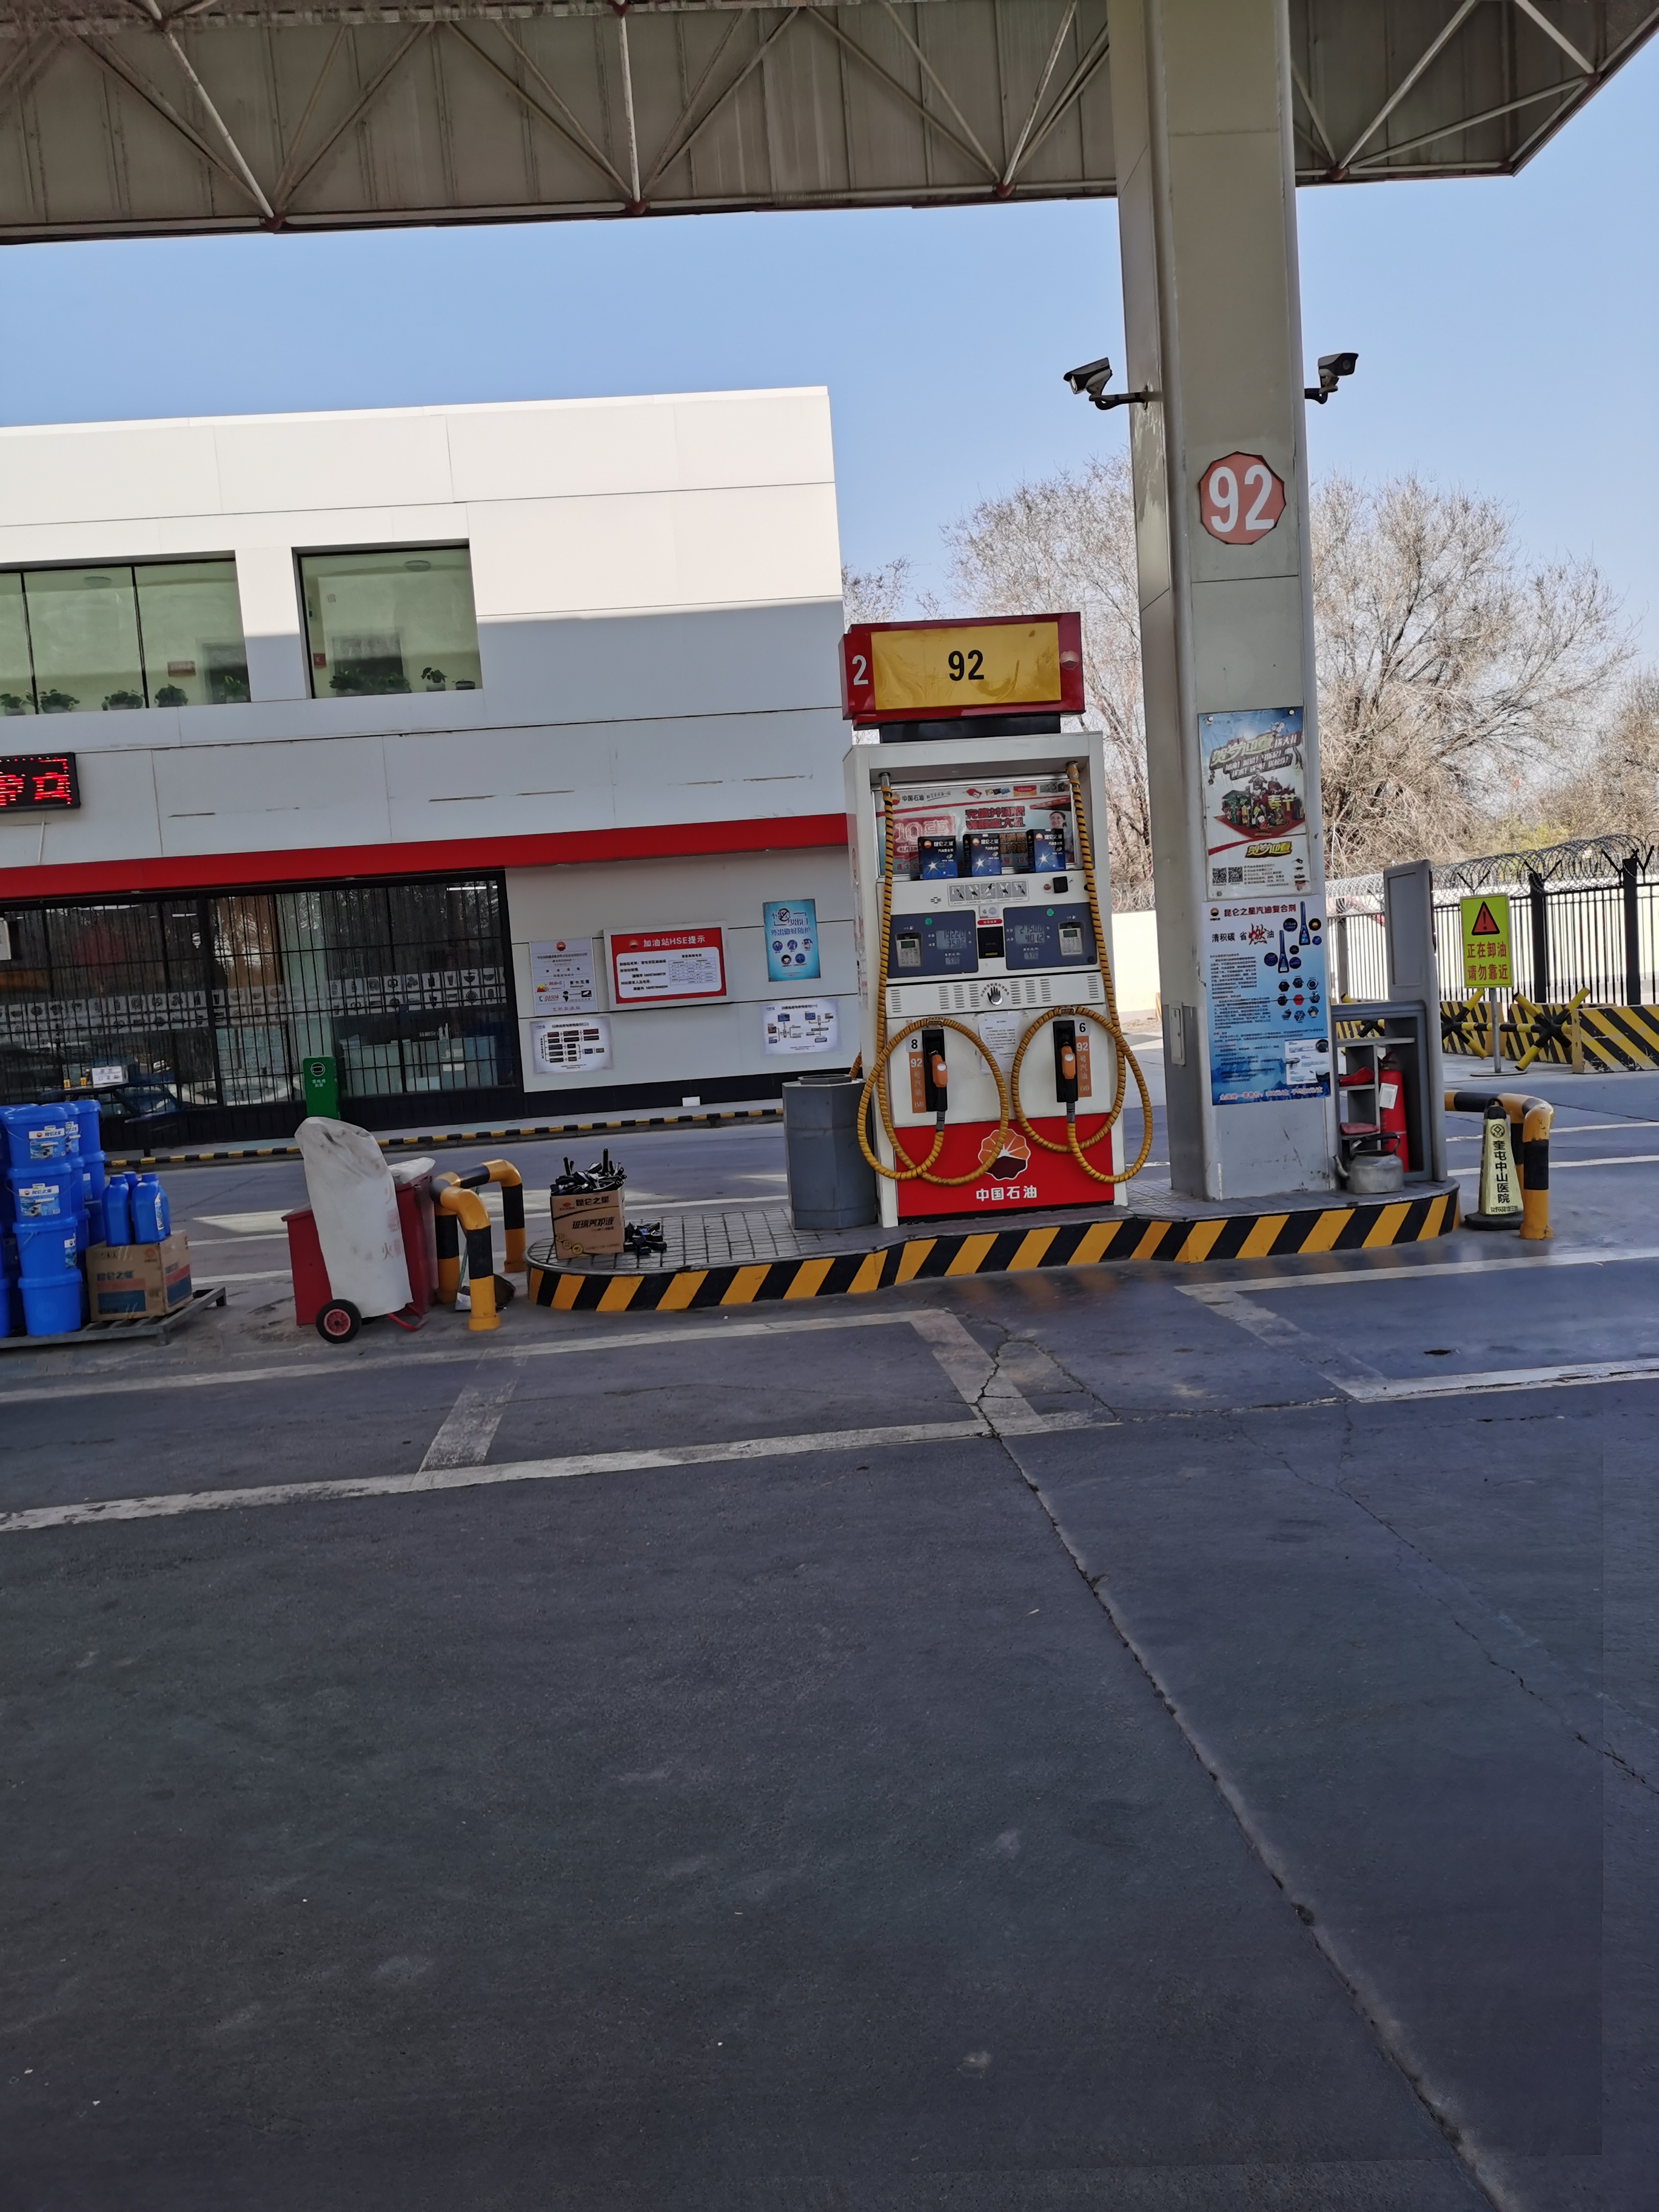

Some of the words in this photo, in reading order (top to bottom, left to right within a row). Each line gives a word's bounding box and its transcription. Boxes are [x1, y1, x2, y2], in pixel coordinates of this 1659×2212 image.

[1208, 464, 1274, 532] 92
[852, 655, 868, 686] 2
[948, 649, 985, 681] 92
[1224, 904, 1296, 917] 昆仑之星汽油复合剂
[643, 936, 705, 947] 加油站HSE提示
[1212, 932, 1236, 942] 清积碳
[1467, 941, 1506, 958] 正在卸油
[1468, 964, 1508, 980] 请勿靠近
[1079, 1022, 1086, 1032] 6
[911, 1039, 918, 1049] 8
[1076, 1042, 1088, 1051] 92
[911, 1059, 922, 1067] 92
[1493, 1140, 1510, 1204] 奎屯中山医院
[976, 1184, 1037, 1202] 中国石油
[572, 1216, 615, 1230] 玻璃养护液
